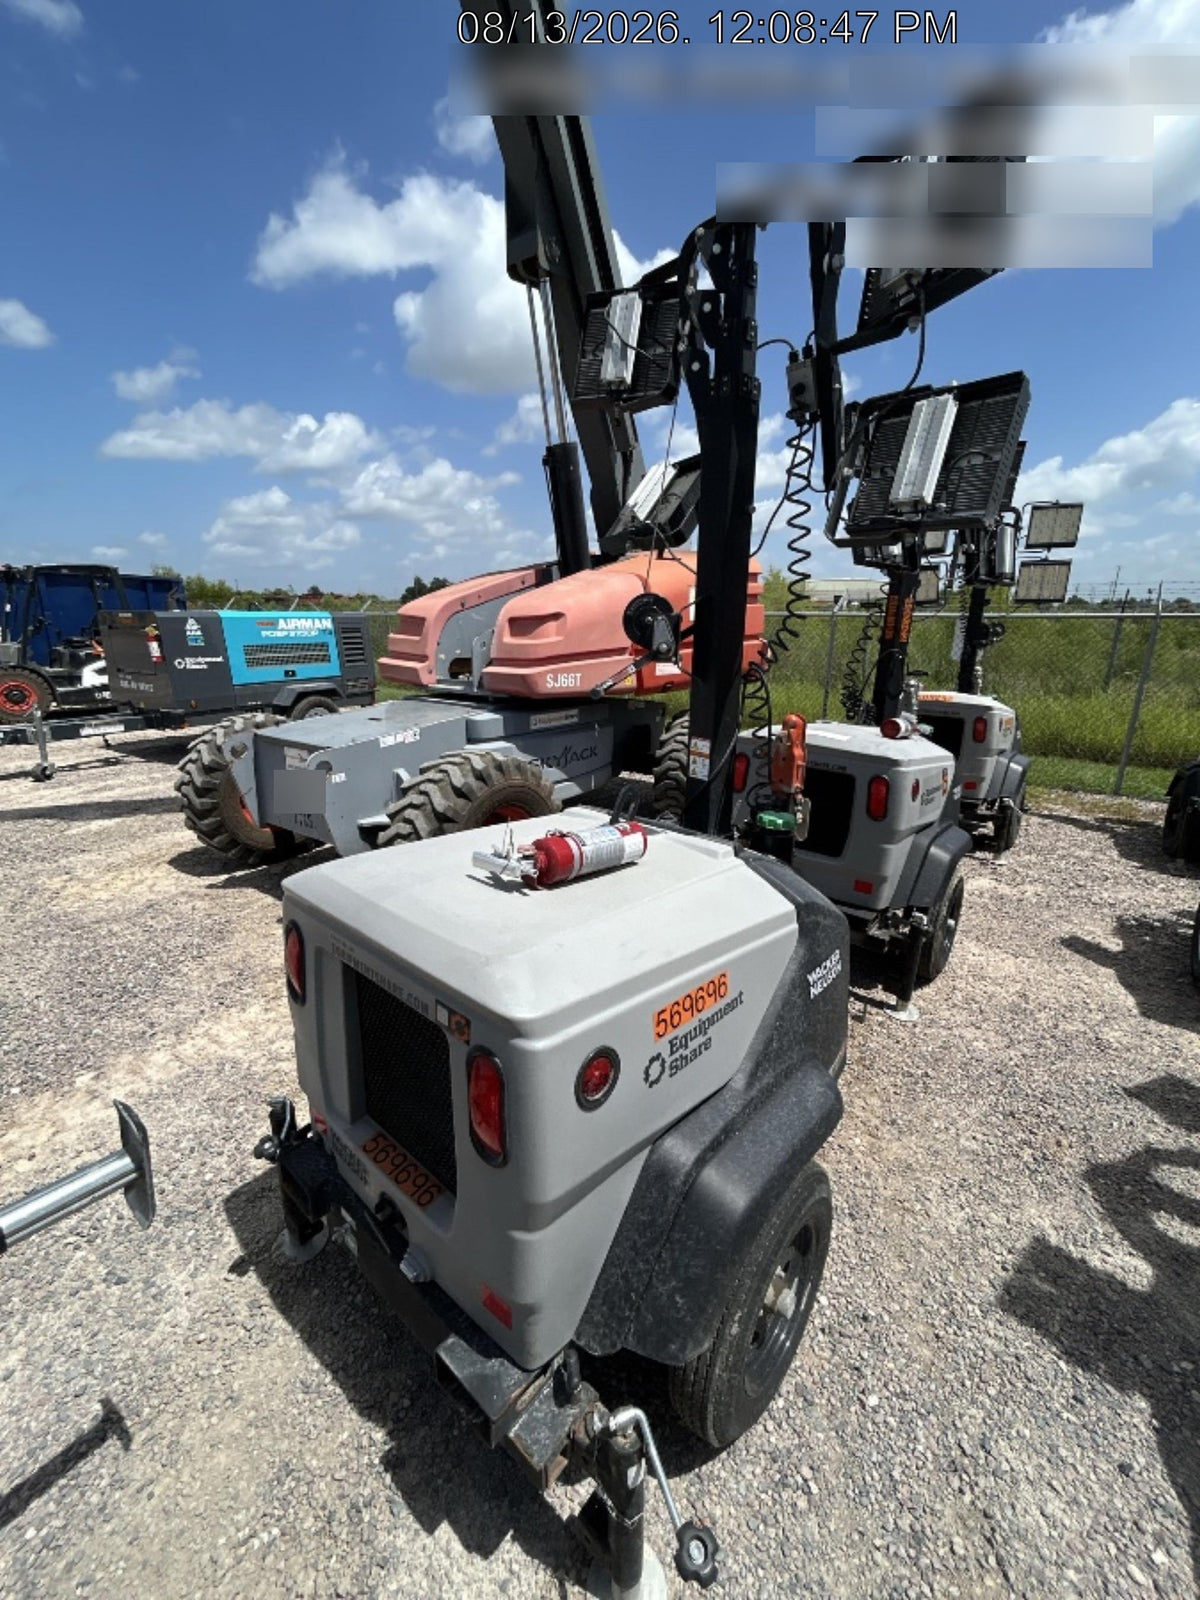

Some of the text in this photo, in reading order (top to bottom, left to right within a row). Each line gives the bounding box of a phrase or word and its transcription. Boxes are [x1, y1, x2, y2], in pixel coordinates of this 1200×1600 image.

[278, 618, 333, 631] AIRMAN
[546, 673, 582, 688] SJ66T
[806, 949, 840, 986] WACKER
[809, 959, 842, 1000] NEUSON
[655, 973, 729, 1038] 569696
[667, 990, 745, 1057] Equipment
[667, 1037, 712, 1078] Share
[363, 1133, 442, 1207] 569696
